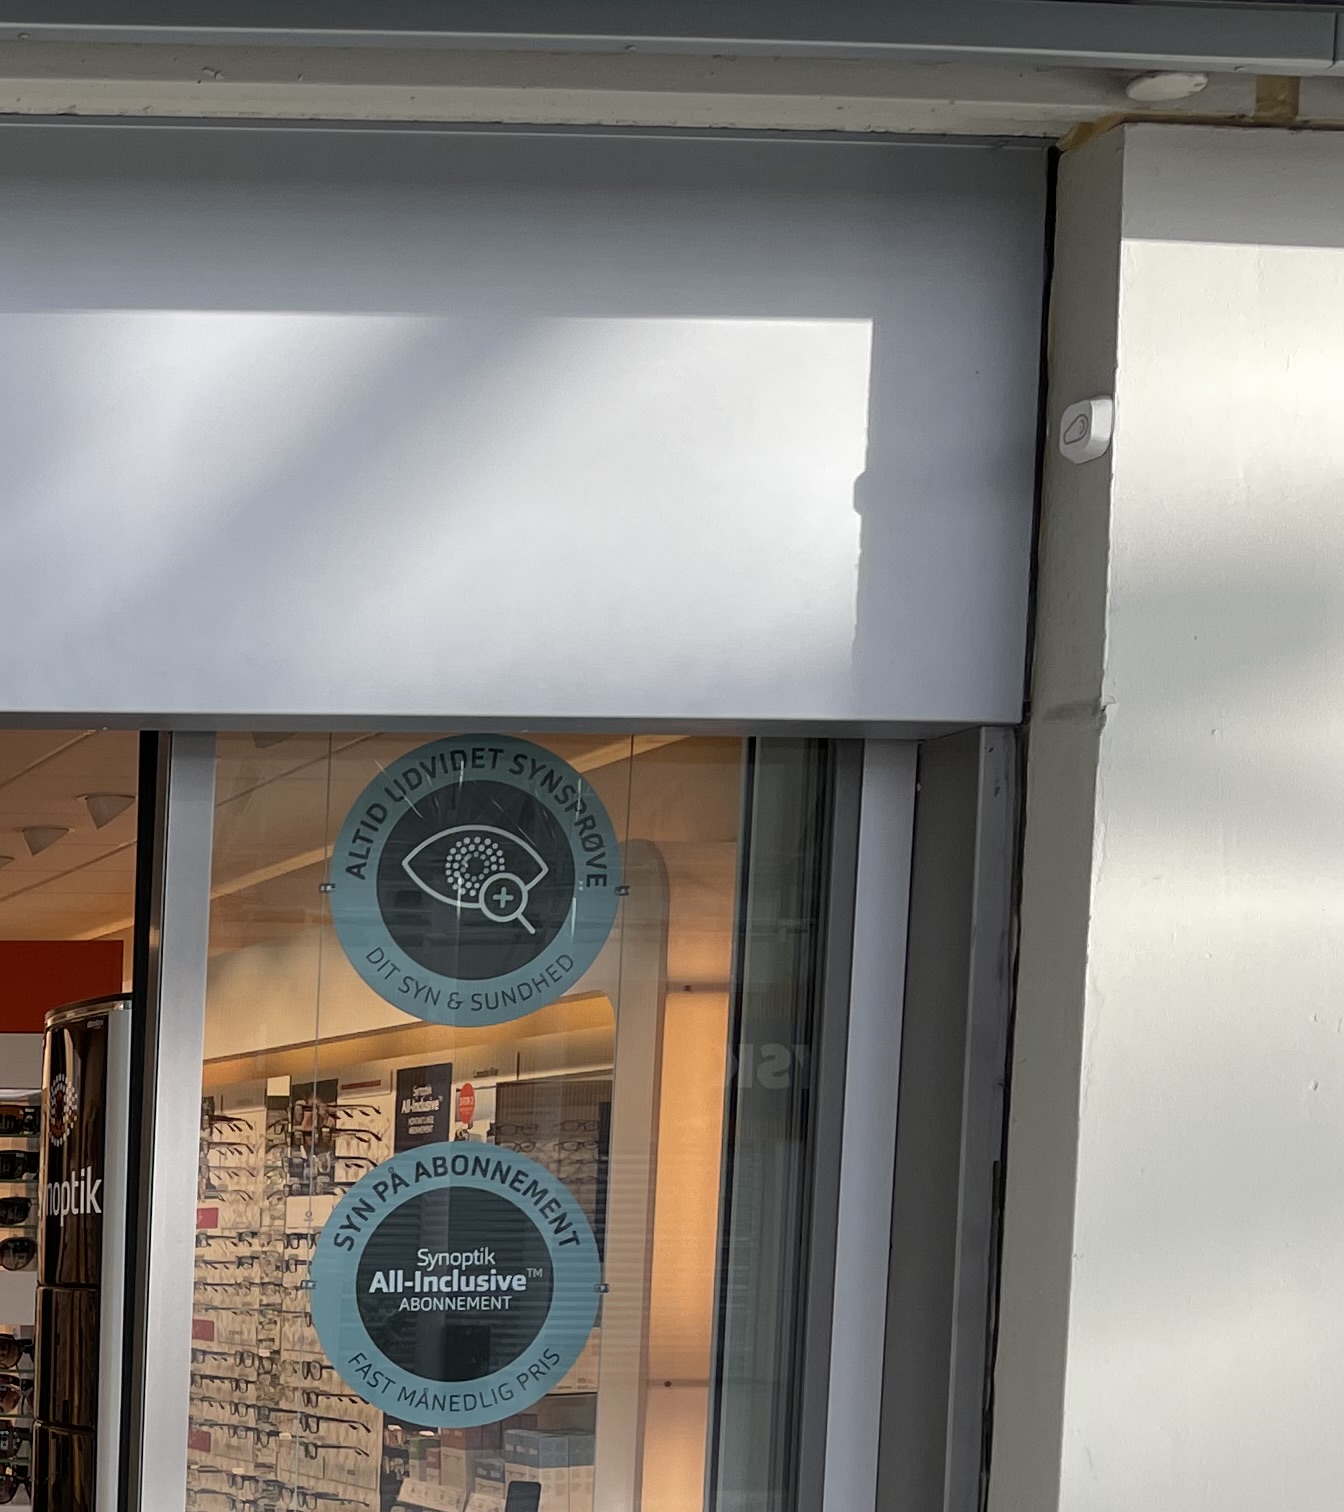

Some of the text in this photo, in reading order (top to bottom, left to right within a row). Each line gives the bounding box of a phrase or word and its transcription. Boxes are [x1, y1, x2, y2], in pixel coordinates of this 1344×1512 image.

[345, 747, 608, 888] ALTID UDVIDET SYNSPRØVE
[366, 946, 574, 1011] DIT SYN & SUNDHED
[45, 1166, 103, 1227] noptik
[334, 1154, 580, 1251] SYN PÅ ABONNEMENT
[416, 1247, 496, 1270] Synoptik
[398, 1295, 512, 1312] ABONNEMENT
[347, 1347, 560, 1412] FAST MÅNEDLIG PRIS
